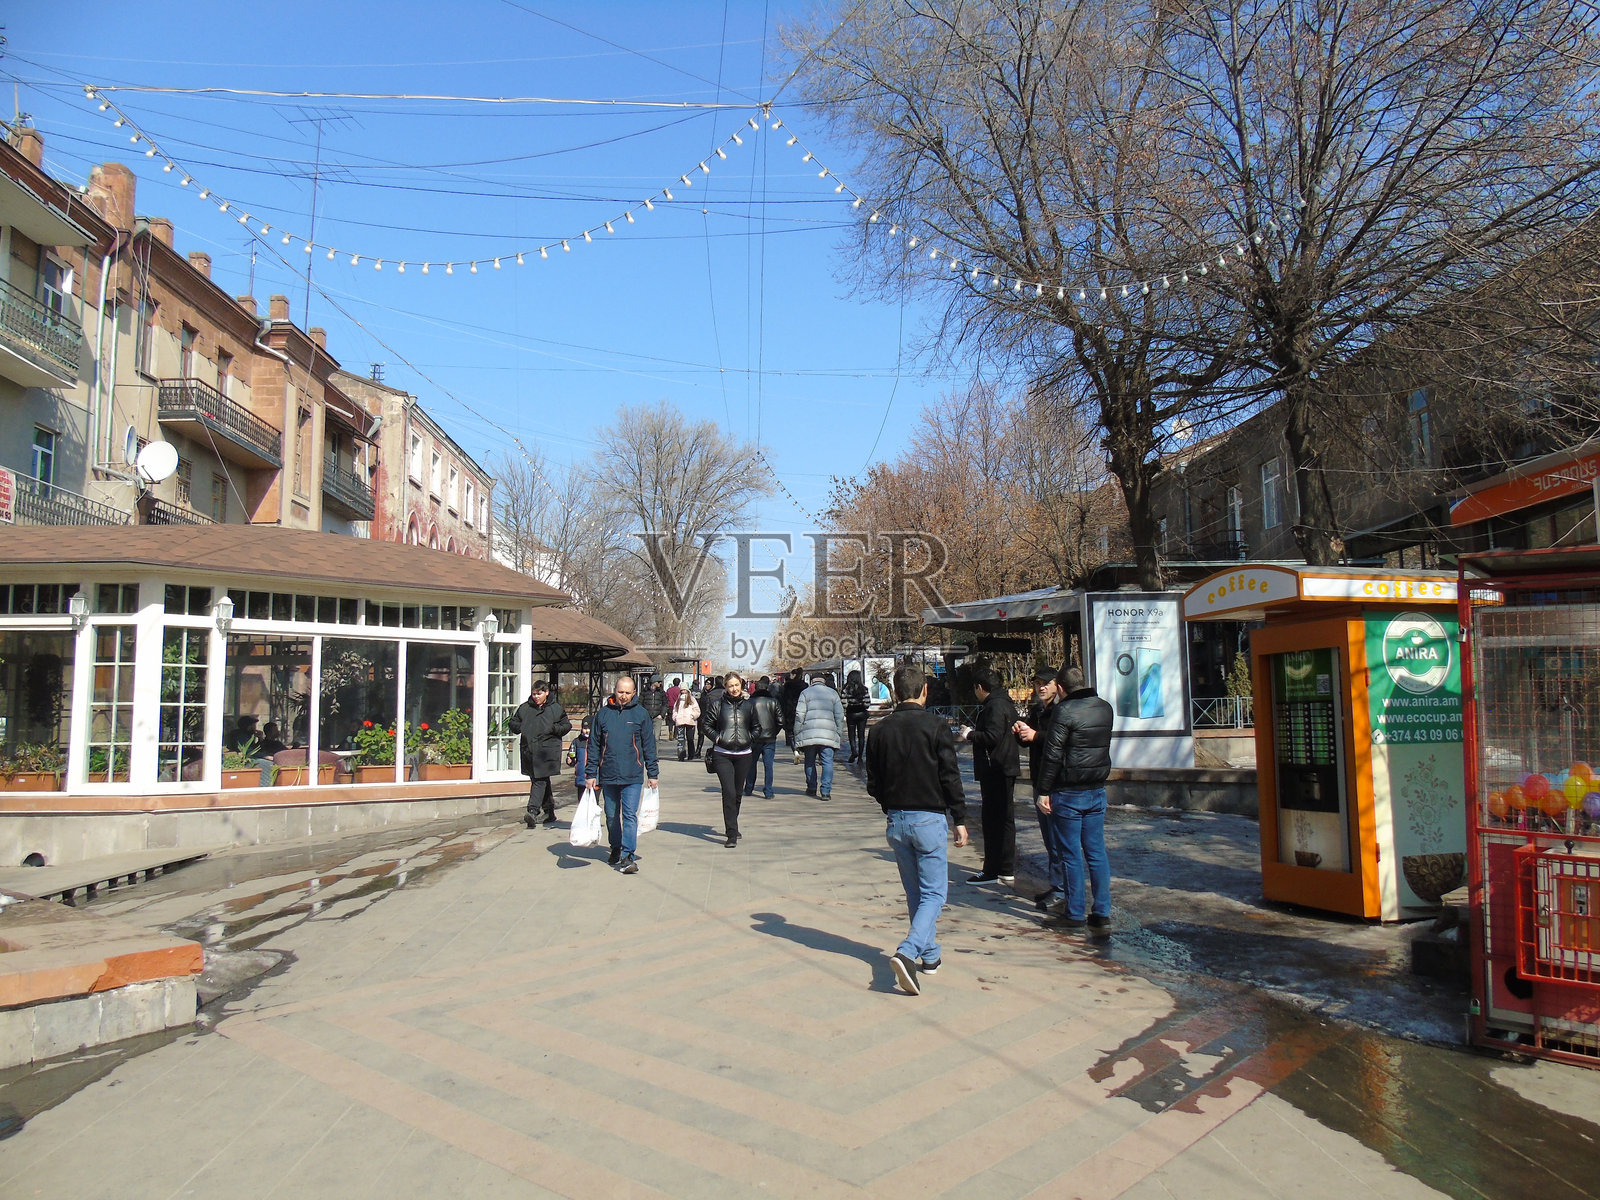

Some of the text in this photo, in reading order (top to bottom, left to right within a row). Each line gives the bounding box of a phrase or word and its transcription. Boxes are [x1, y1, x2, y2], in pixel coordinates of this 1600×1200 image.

[1207, 574, 1268, 604] coffee
[1363, 580, 1442, 597] coffee
[1107, 608, 1164, 617] HONOR X9a
[1395, 647, 1438, 660] ANIRA
[1382, 696, 1458, 707] www.anira.am
[1384, 730, 1411, 741] +374
[1414, 730, 1427, 740] 43
[1430, 729, 1443, 740] 09
[1446, 729, 1459, 740] 06
